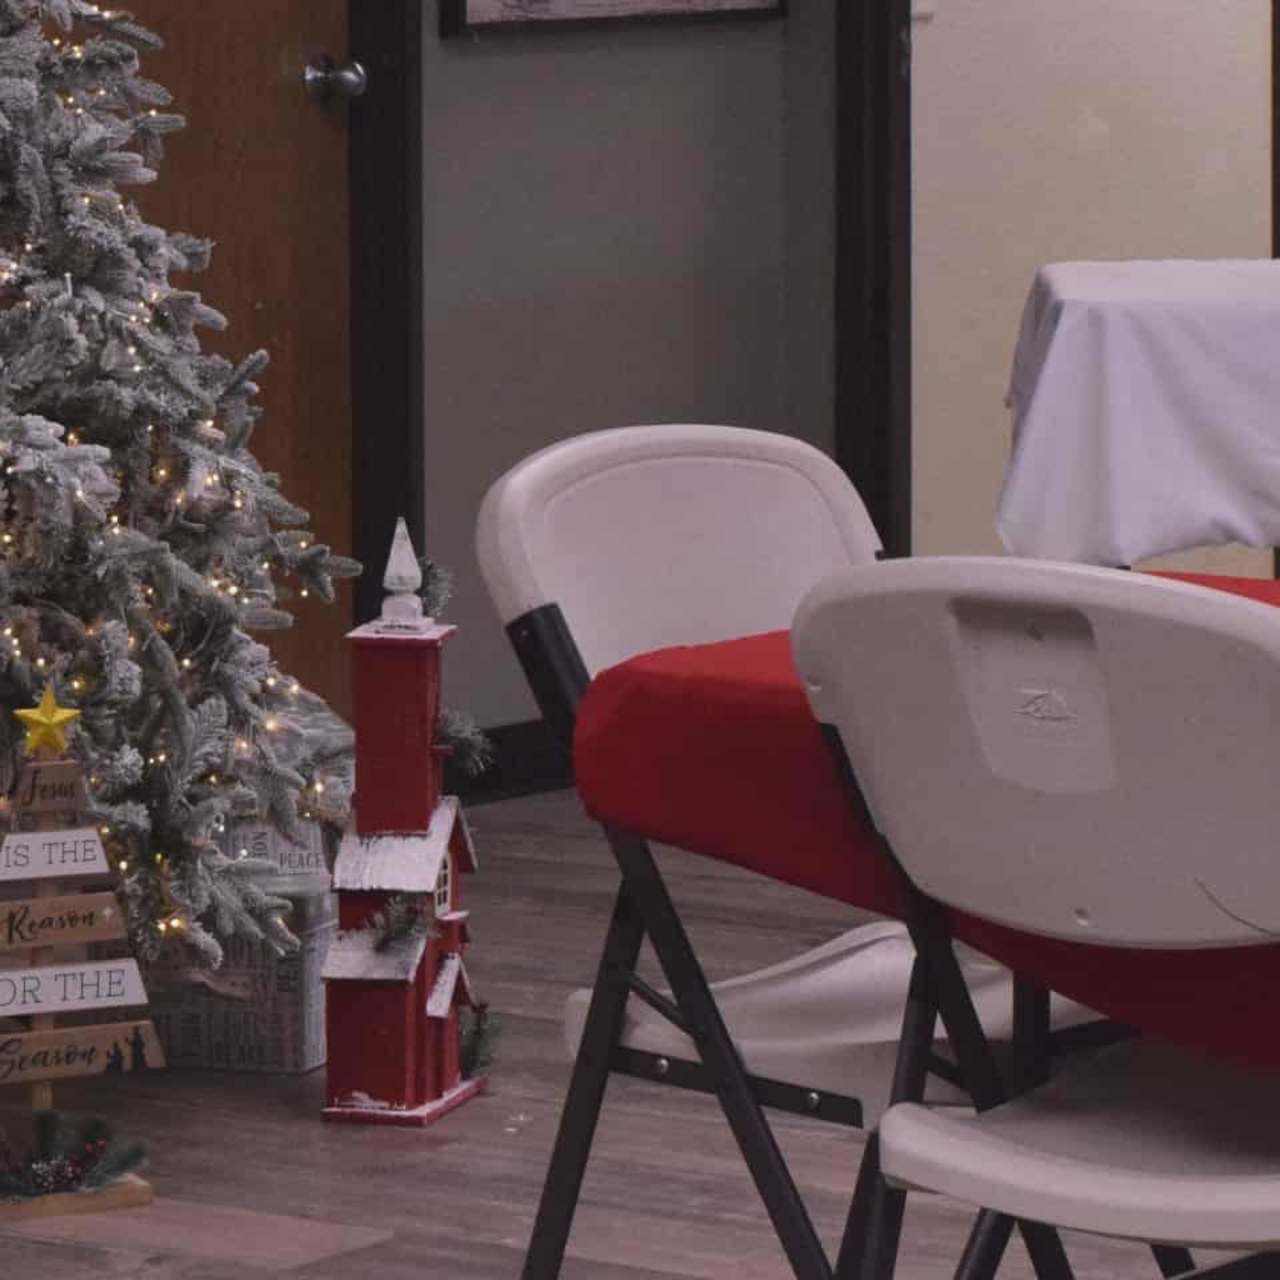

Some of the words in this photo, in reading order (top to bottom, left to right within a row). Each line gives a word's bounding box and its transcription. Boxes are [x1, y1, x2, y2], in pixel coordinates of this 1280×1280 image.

[20, 767, 77, 806] Jesus
[4, 843, 30, 869] IS
[41, 839, 98, 865] THE
[6, 906, 96, 944] Reason
[54, 969, 126, 1002] THE
